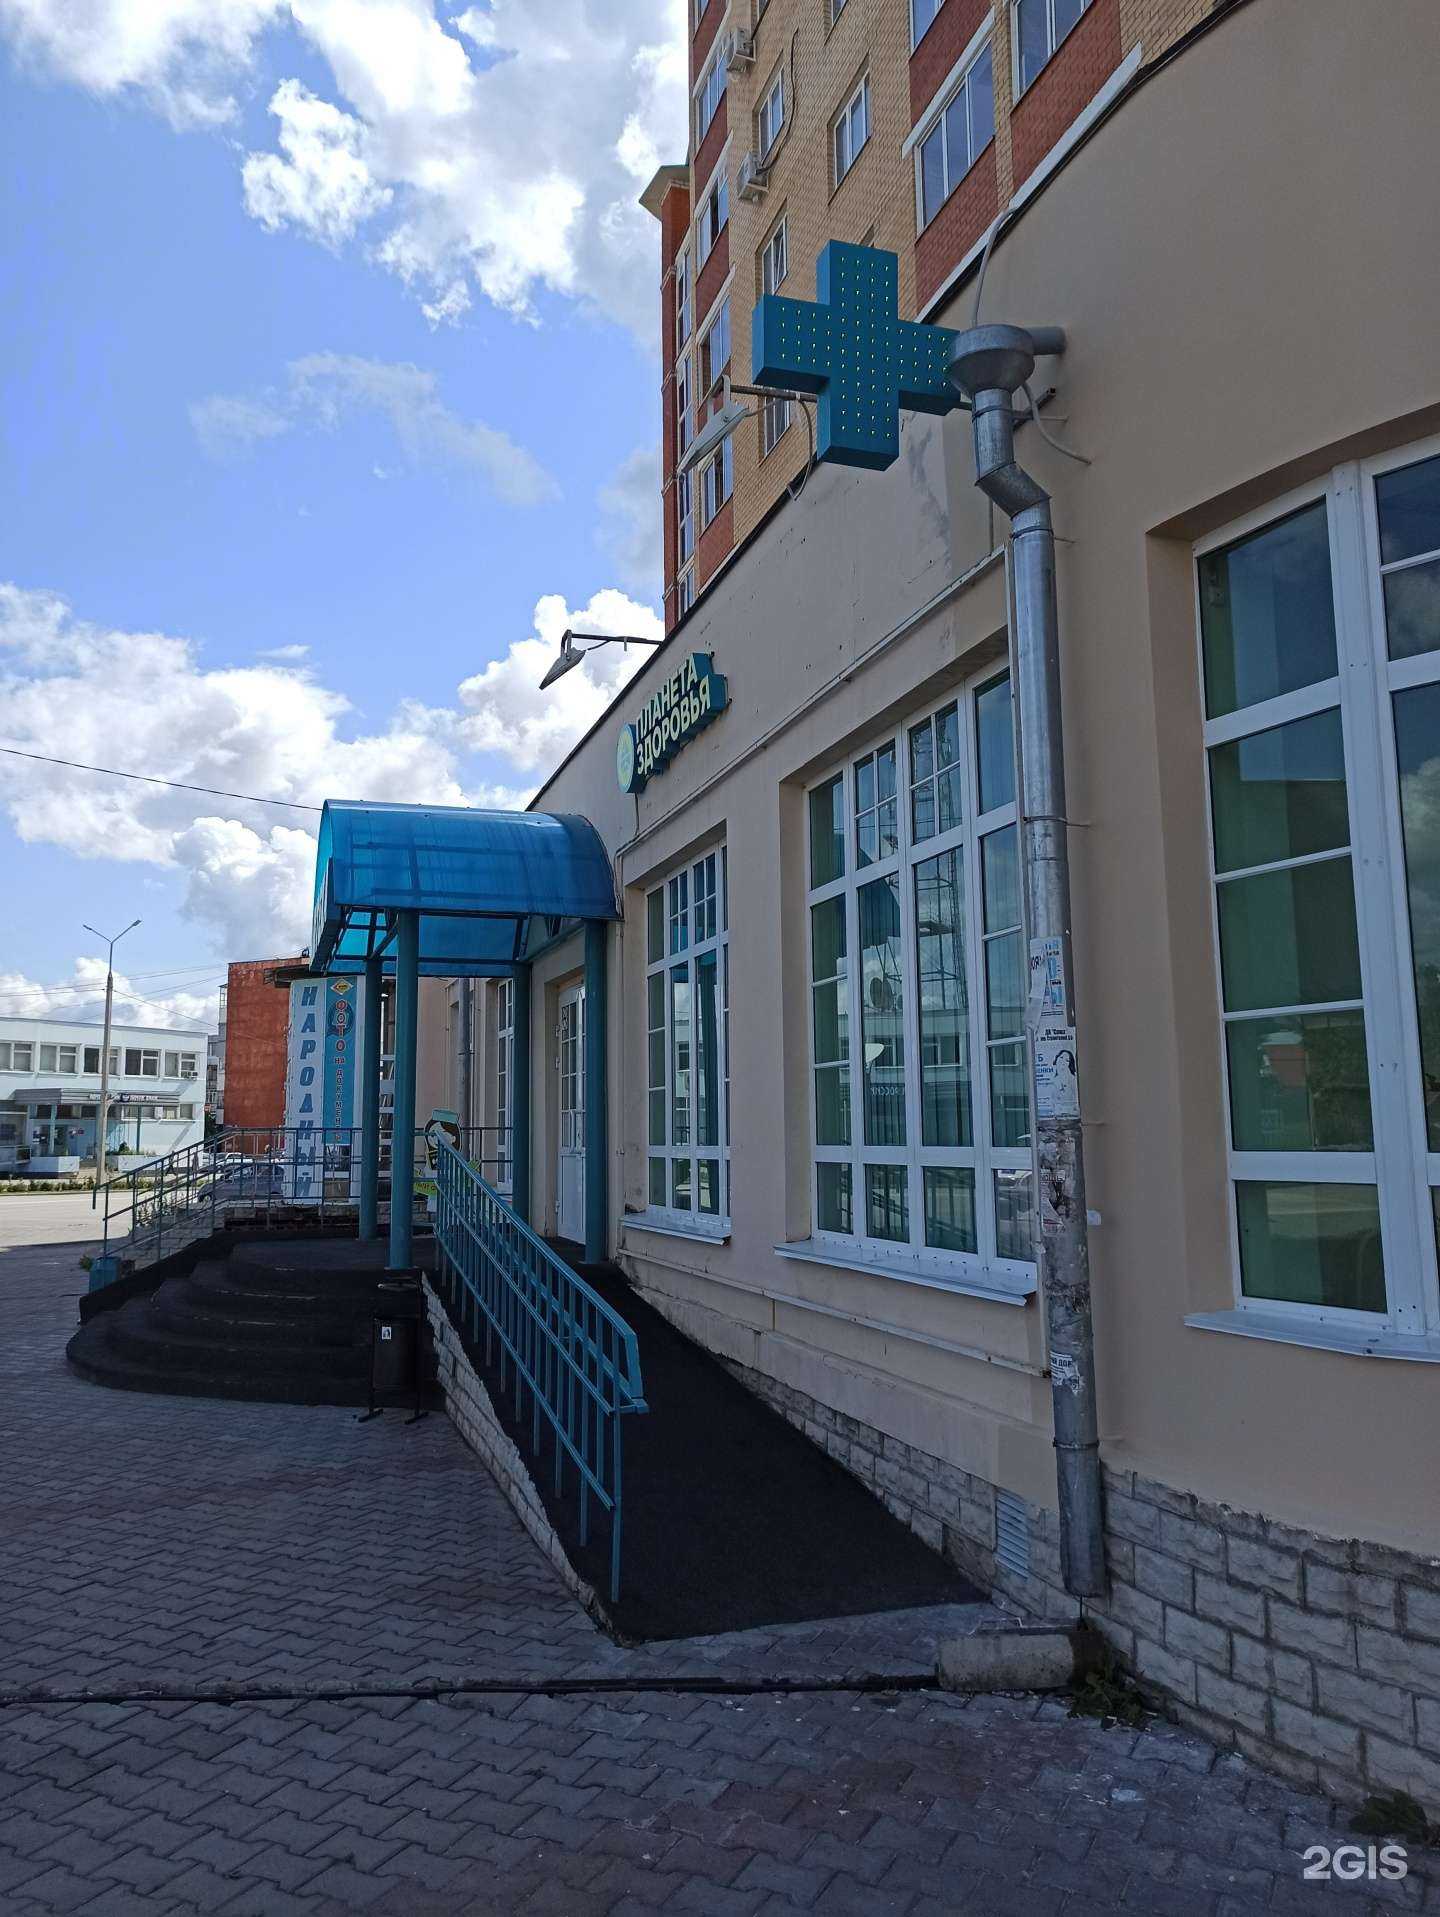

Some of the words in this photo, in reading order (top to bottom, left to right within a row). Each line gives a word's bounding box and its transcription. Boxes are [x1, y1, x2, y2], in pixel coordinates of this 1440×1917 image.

[635, 653, 698, 744] ПЛАНЕТА
[636, 674, 711, 775] ЗДОРОВЬЯ
[335, 998, 347, 1052] ФОТО
[295, 985, 318, 1197] НАРОДНЫЙ
